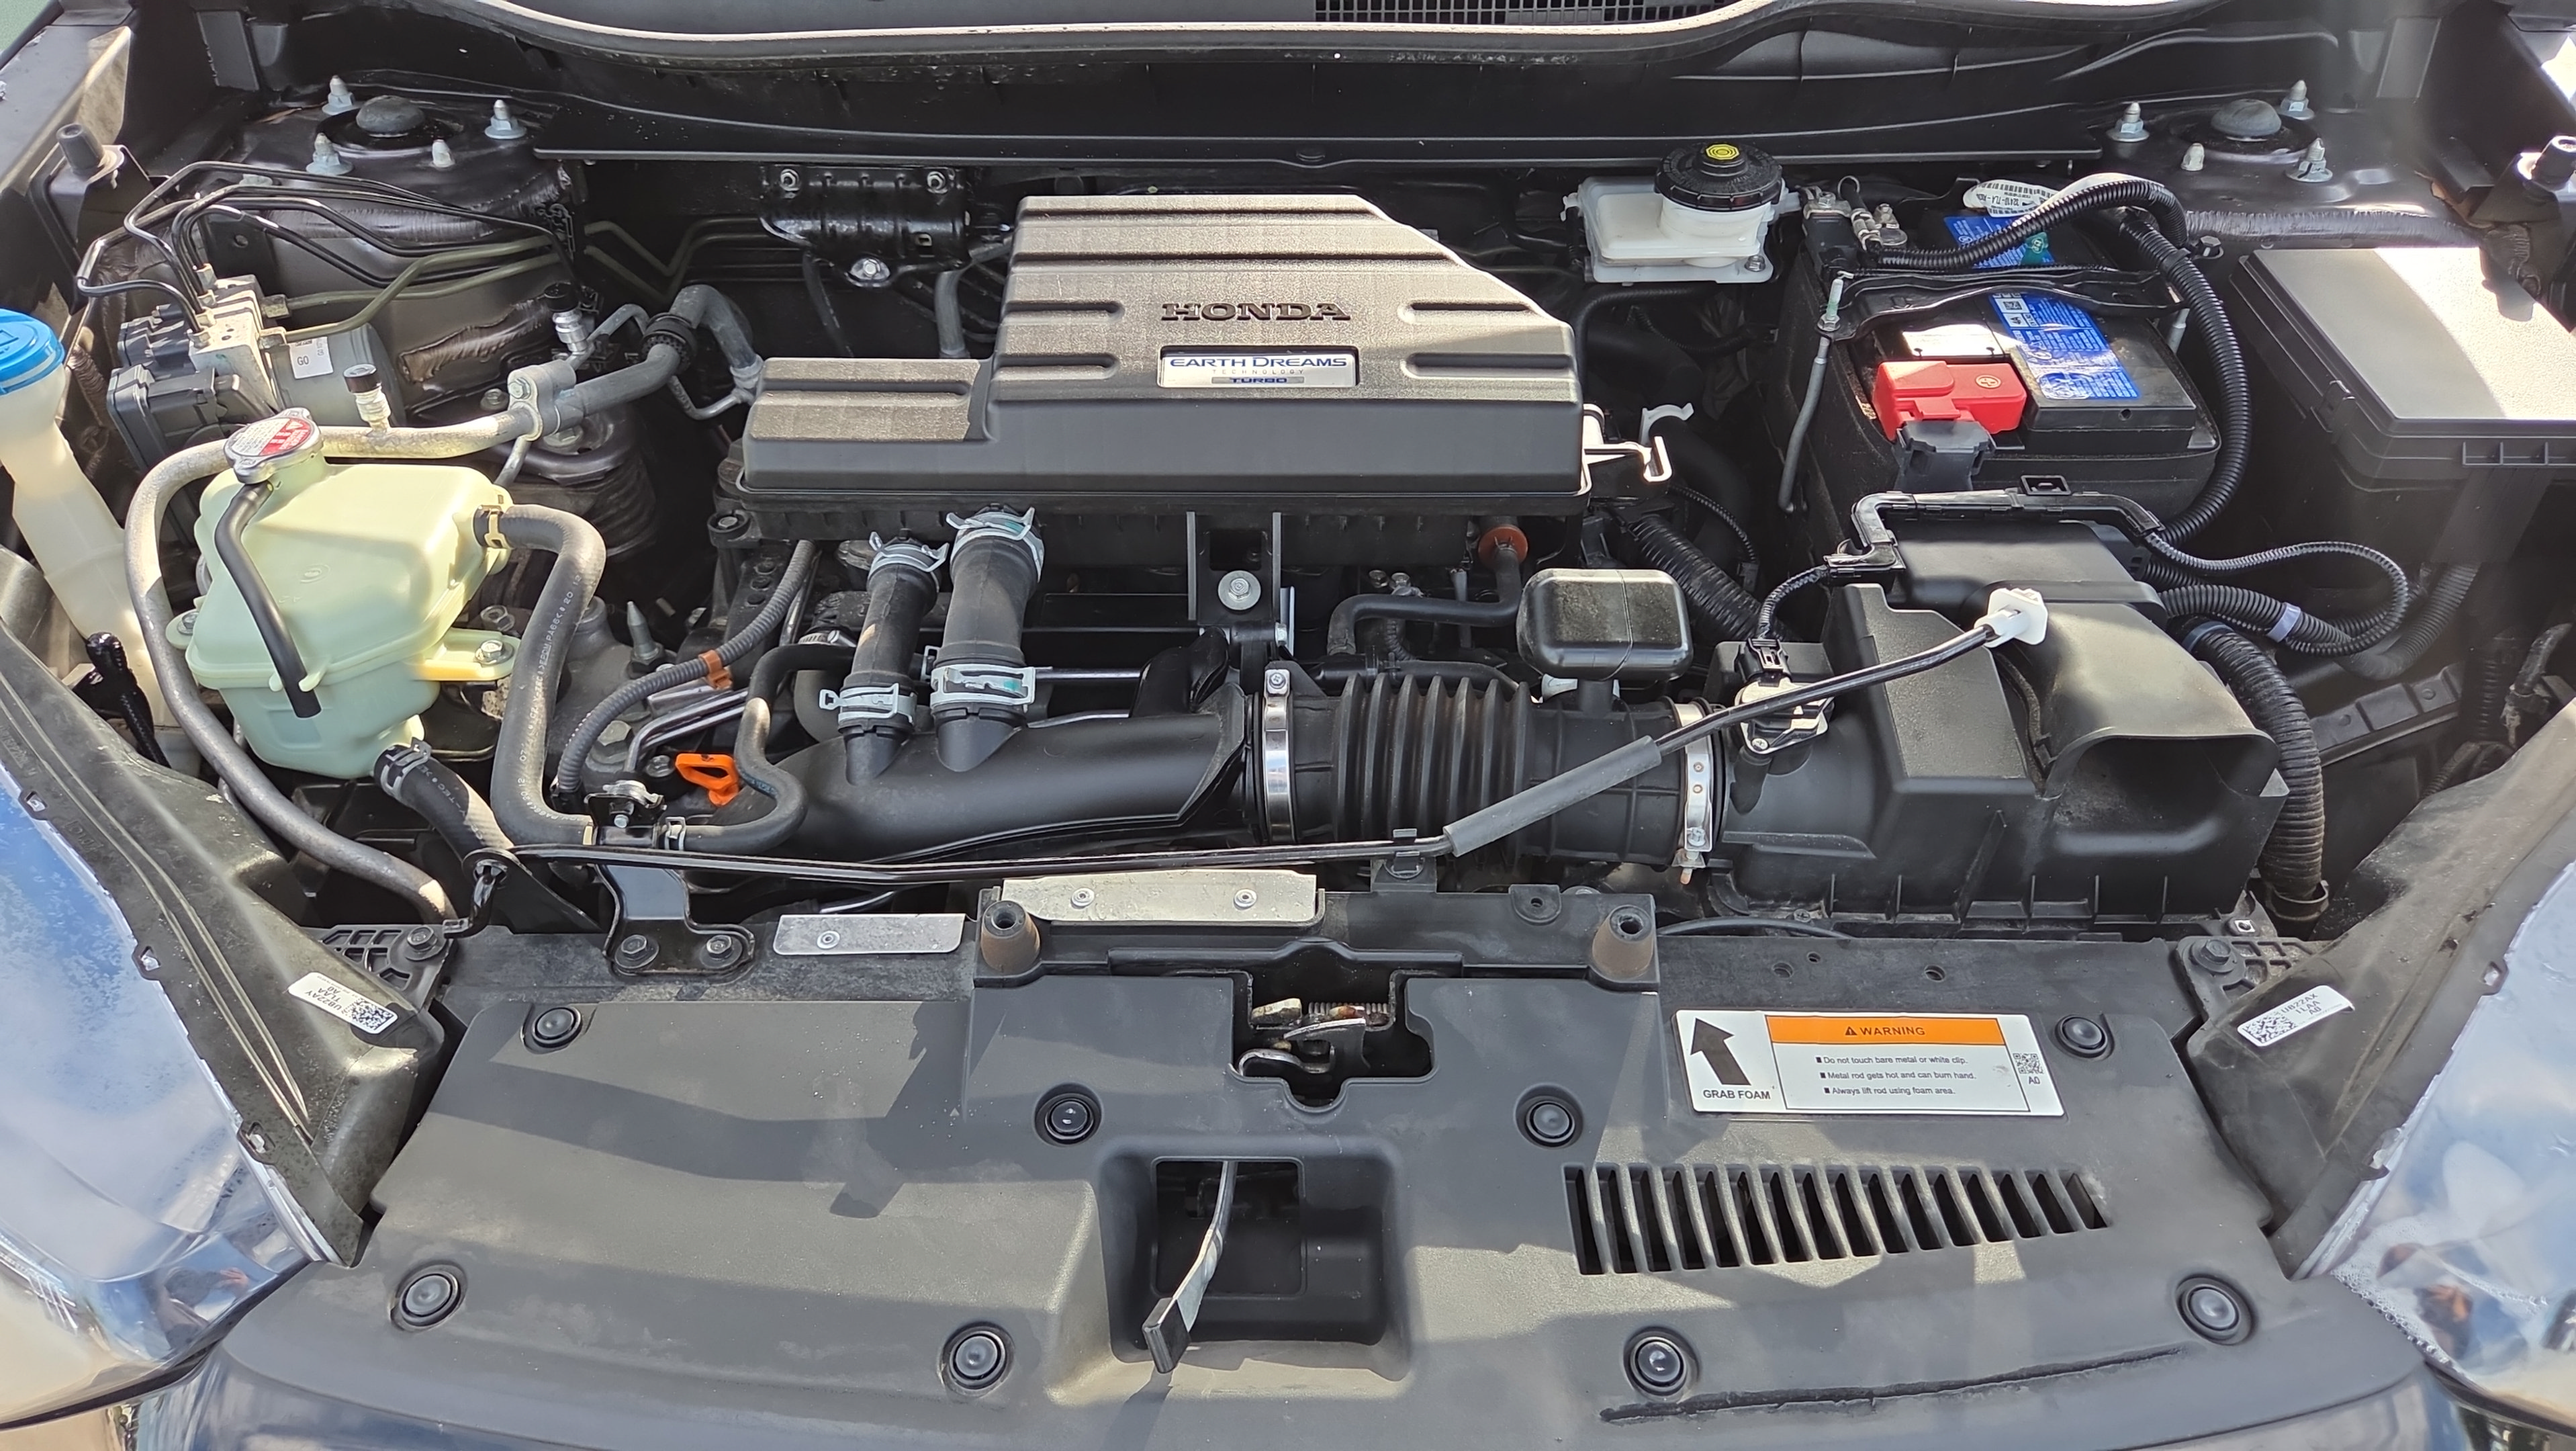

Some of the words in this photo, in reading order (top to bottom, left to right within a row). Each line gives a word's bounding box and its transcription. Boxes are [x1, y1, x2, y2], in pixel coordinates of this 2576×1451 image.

[1161, 303, 1351, 321] HONDA
[1170, 358, 1246, 367] EARTH
[1252, 357, 1347, 367] DREAMS
[563, 591, 574, 605] 20
[304, 990, 342, 1010] UB22AY
[318, 987, 341, 1003] TLAA
[2281, 993, 2319, 1014] UB22AX
[1859, 1026, 1926, 1036] WARNING
[1951, 1057, 1968, 1065] clip.
[1703, 1090, 1735, 1099] GRAB
[1738, 1090, 1771, 1100] FOAM
[1832, 1088, 1860, 1096] Always
[1889, 1088, 1911, 1096] using
